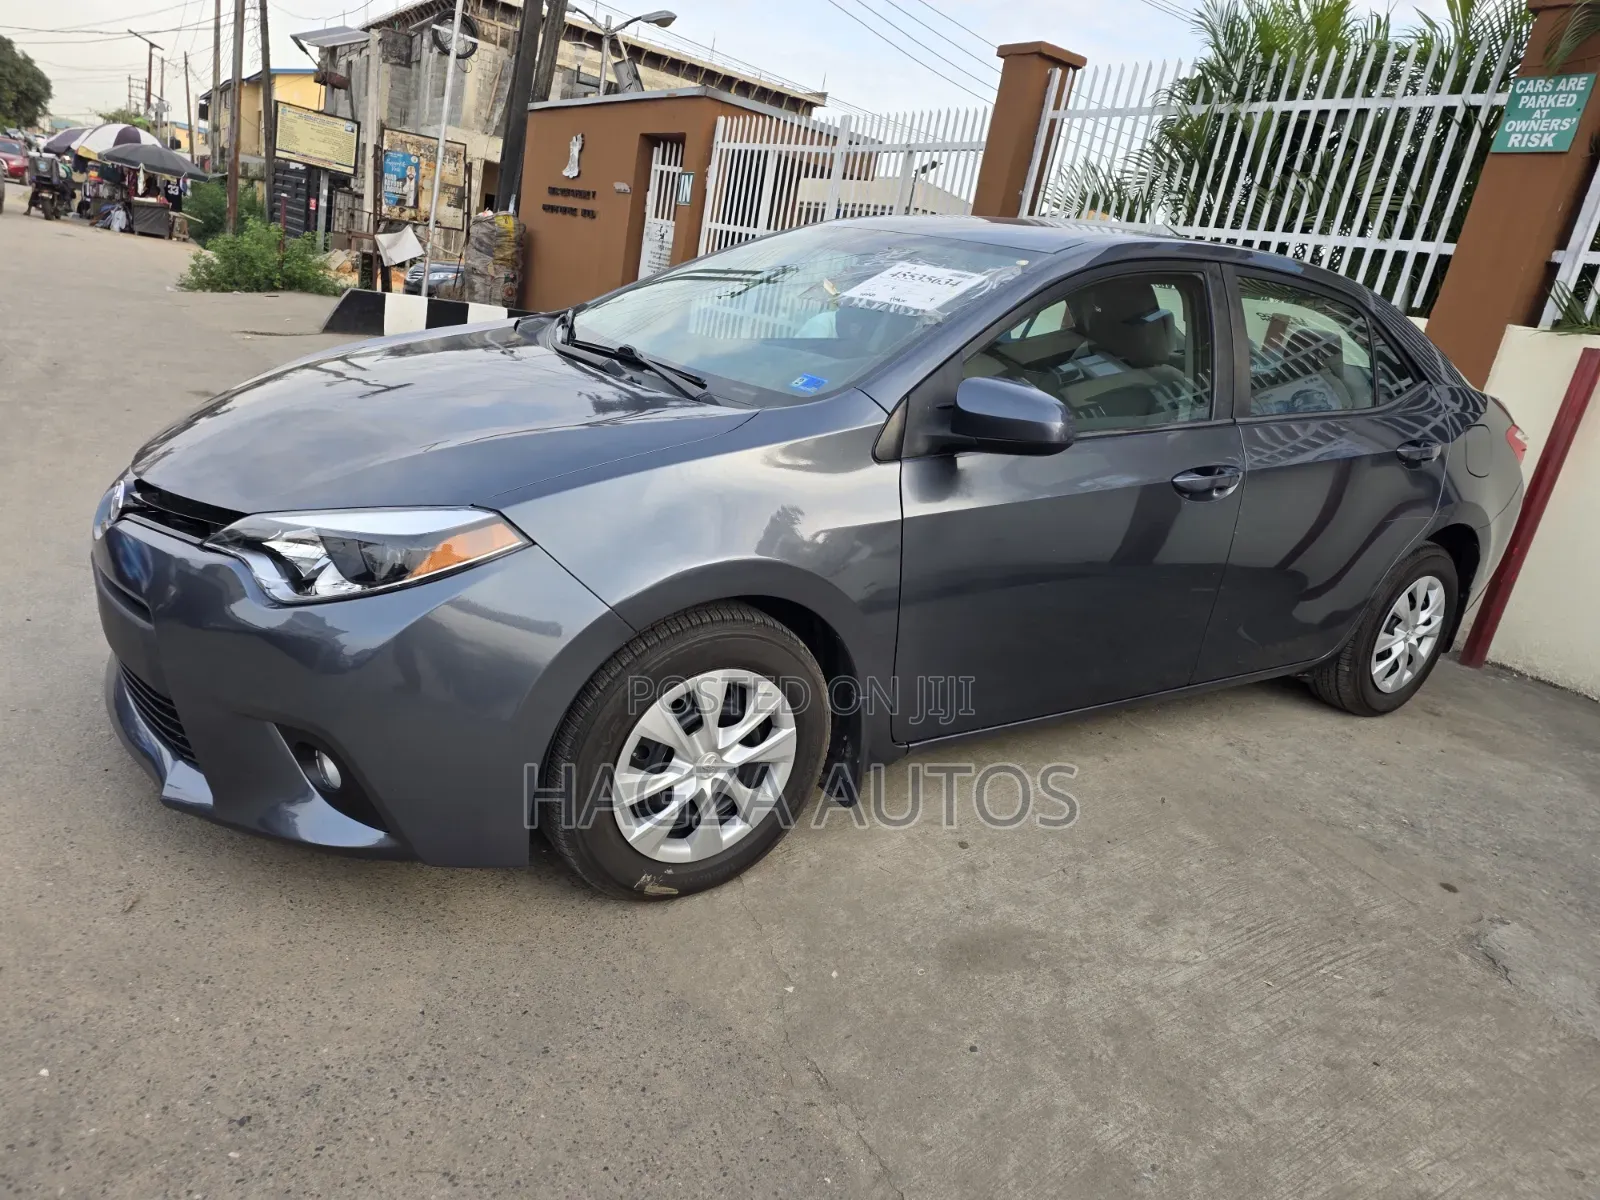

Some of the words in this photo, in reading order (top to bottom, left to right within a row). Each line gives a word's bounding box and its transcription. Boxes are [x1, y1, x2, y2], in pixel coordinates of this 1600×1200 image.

[1516, 79, 1554, 94] CARS
[1556, 77, 1588, 92] ARE
[1518, 94, 1577, 109] PARKED
[1531, 109, 1550, 119] AT
[1507, 133, 1558, 148] RISK
[167, 184, 179, 195] 33
[679, 174, 694, 203] IN
